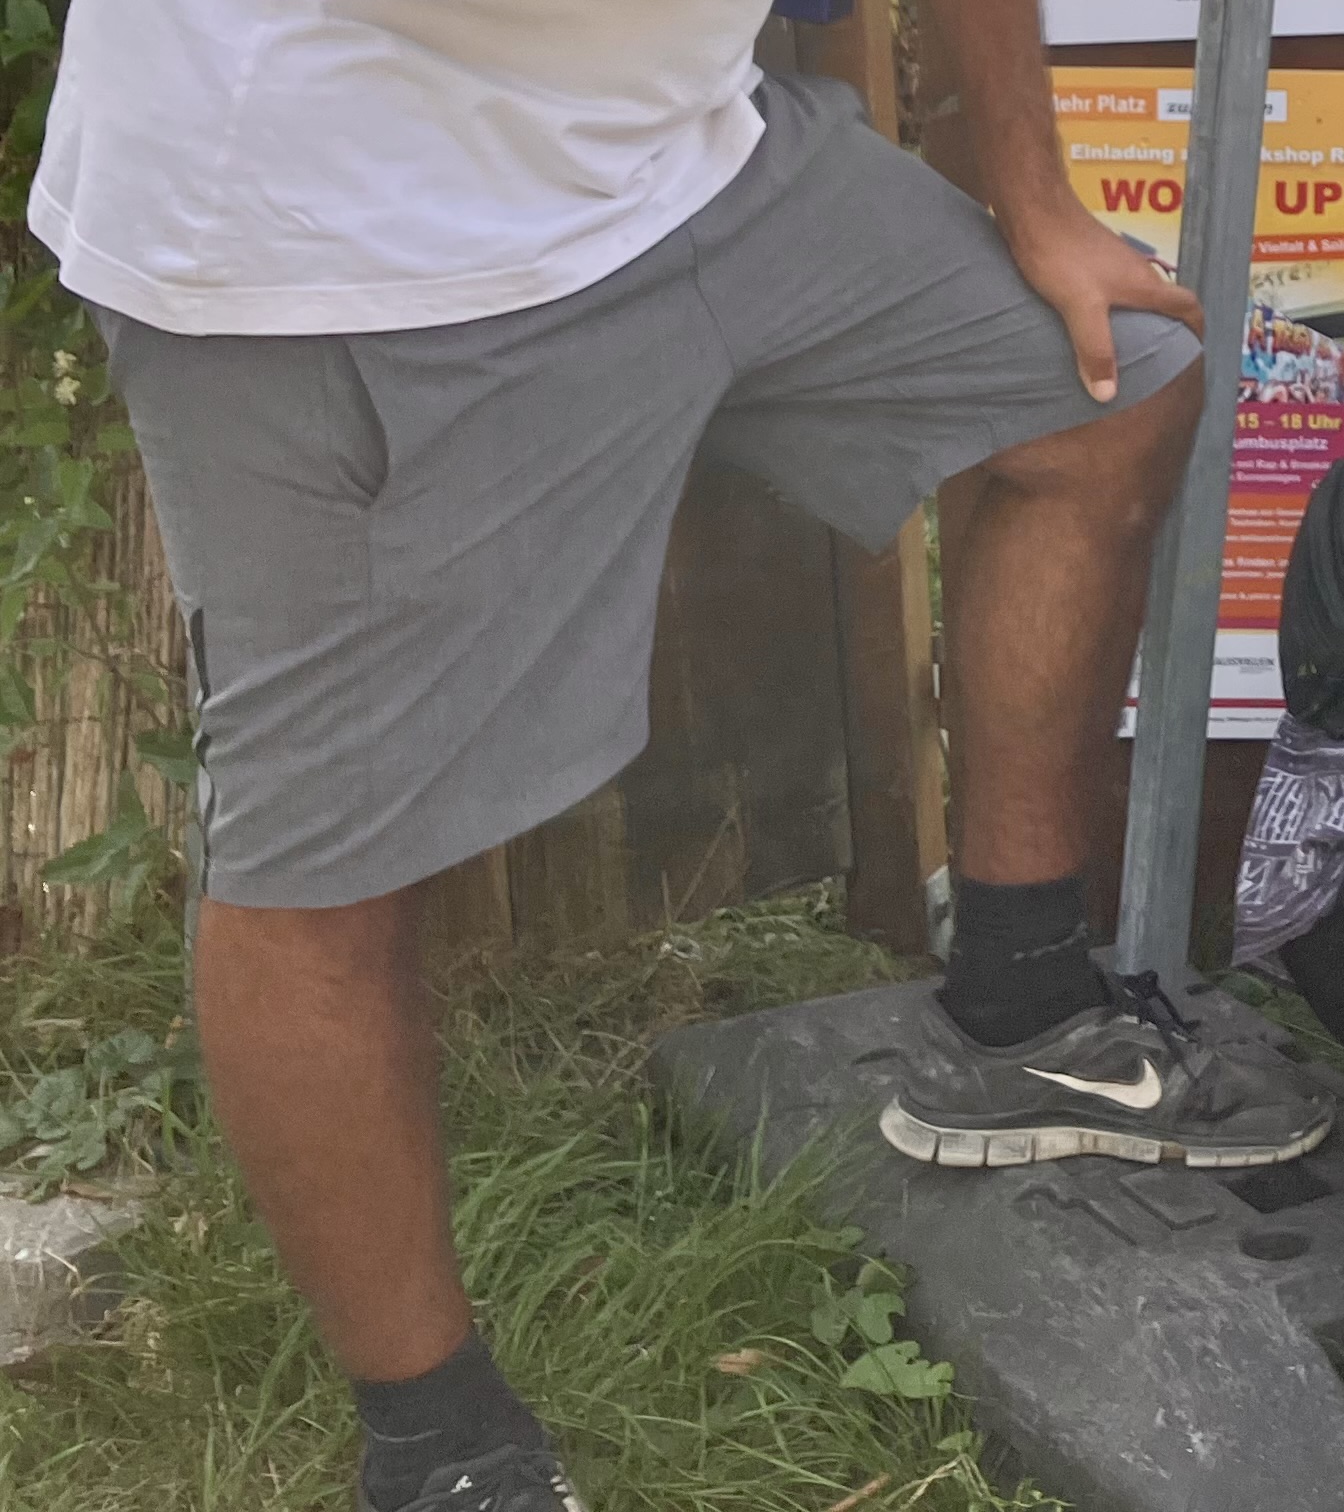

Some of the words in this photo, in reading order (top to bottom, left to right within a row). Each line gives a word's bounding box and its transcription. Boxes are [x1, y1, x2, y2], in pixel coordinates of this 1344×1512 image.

[1053, 94, 1090, 113] ehr
[1097, 95, 1147, 113] Platz
[1070, 143, 1174, 165] Einladung
[1101, 178, 1183, 213] WO
[1237, 412, 1260, 429] 15
[1308, 414, 1343, 430] Uhr
